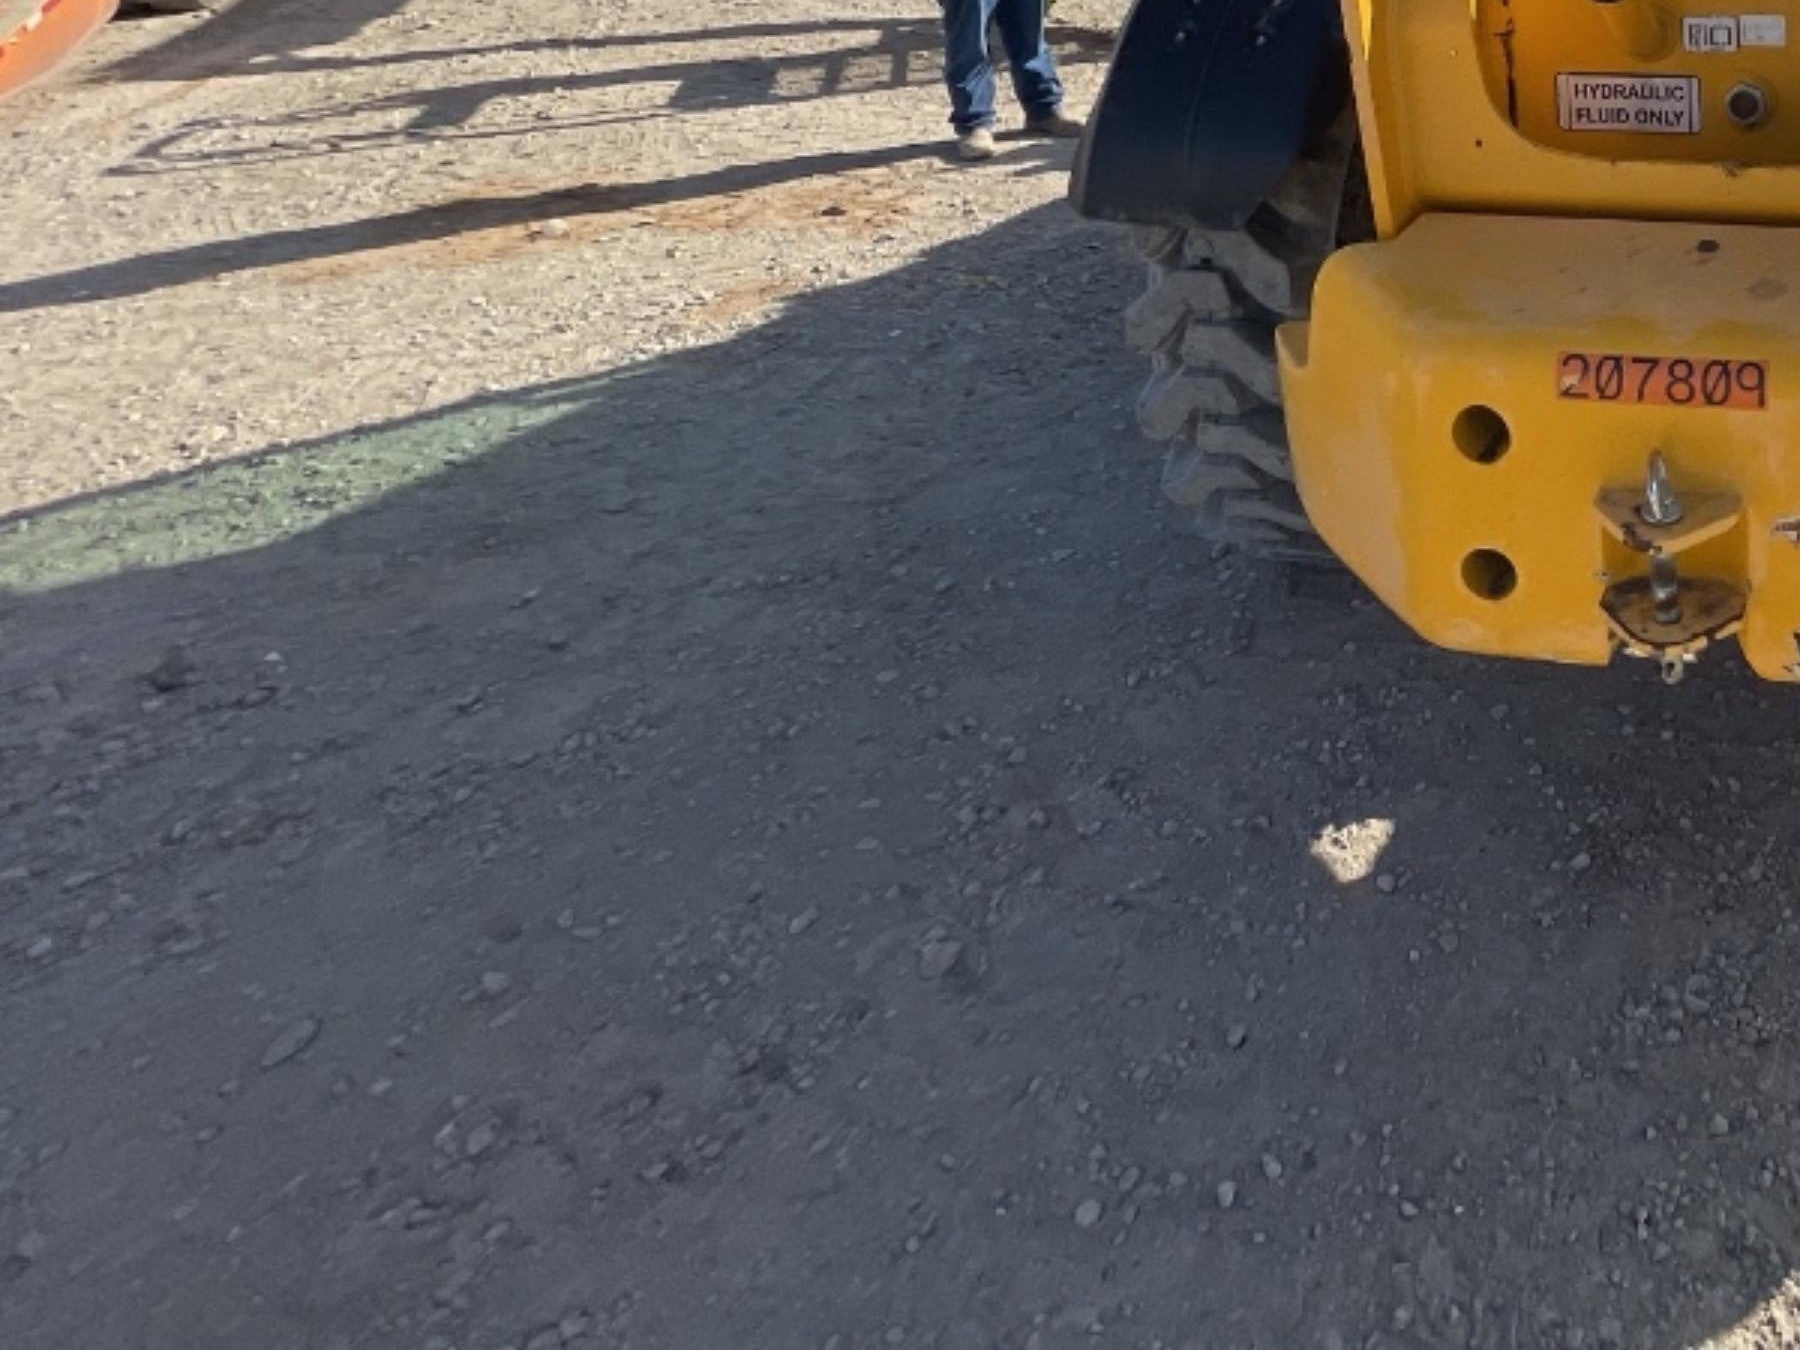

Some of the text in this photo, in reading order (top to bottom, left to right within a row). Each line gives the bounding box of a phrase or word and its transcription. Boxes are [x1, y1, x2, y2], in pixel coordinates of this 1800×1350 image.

[1574, 82, 1685, 102] HYDRAULIC
[1576, 107, 1685, 127] FLUID ONLY
[1560, 353, 1766, 408] 207809
